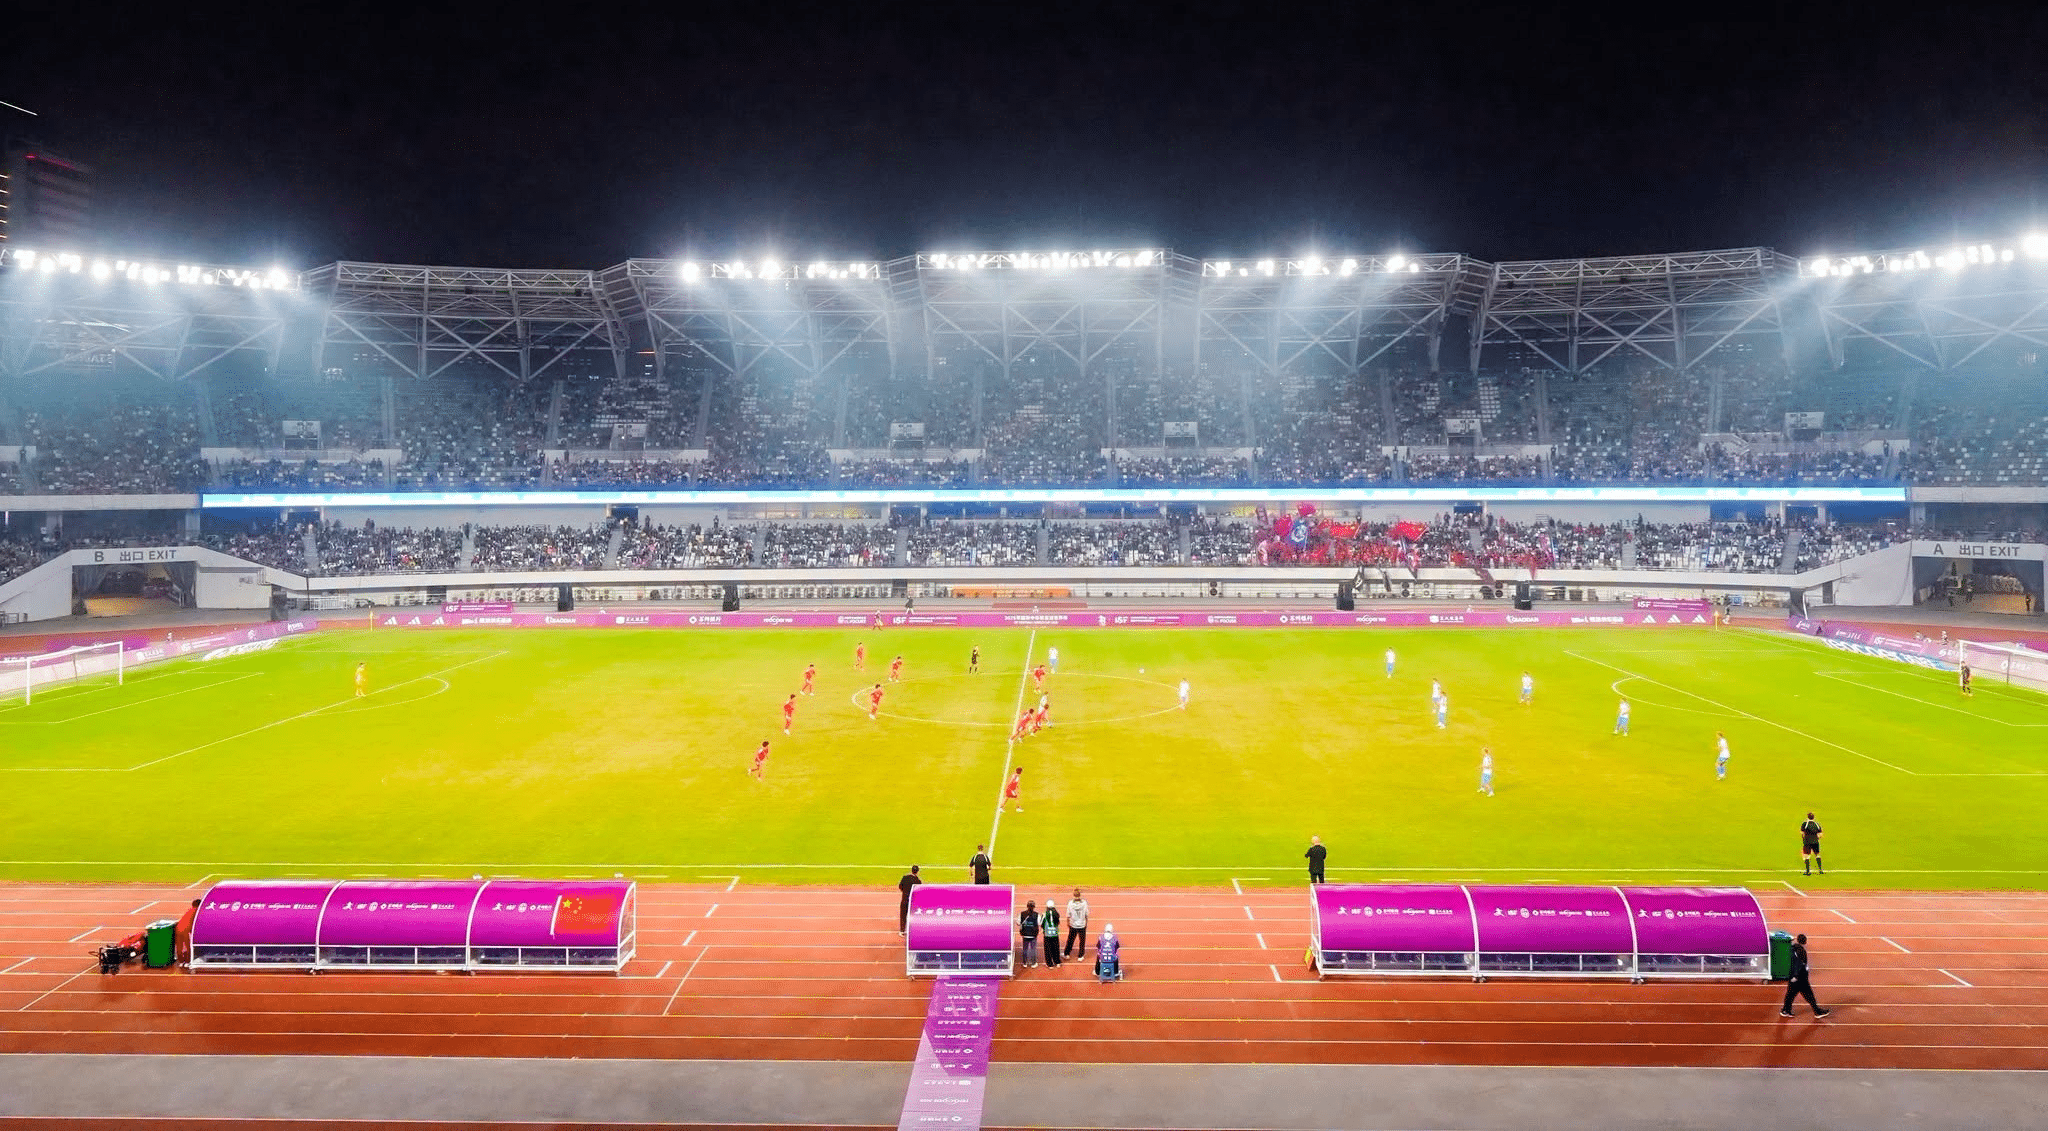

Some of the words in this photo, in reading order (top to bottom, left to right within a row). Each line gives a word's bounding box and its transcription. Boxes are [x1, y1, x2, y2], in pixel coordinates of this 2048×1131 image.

[1933, 543, 1944, 555] A
[1959, 544, 1984, 556] 出口
[1990, 546, 2021, 557] EXIT
[94, 551, 104, 562] B
[119, 551, 144, 561] 出口
[149, 550, 177, 560] EXIT
